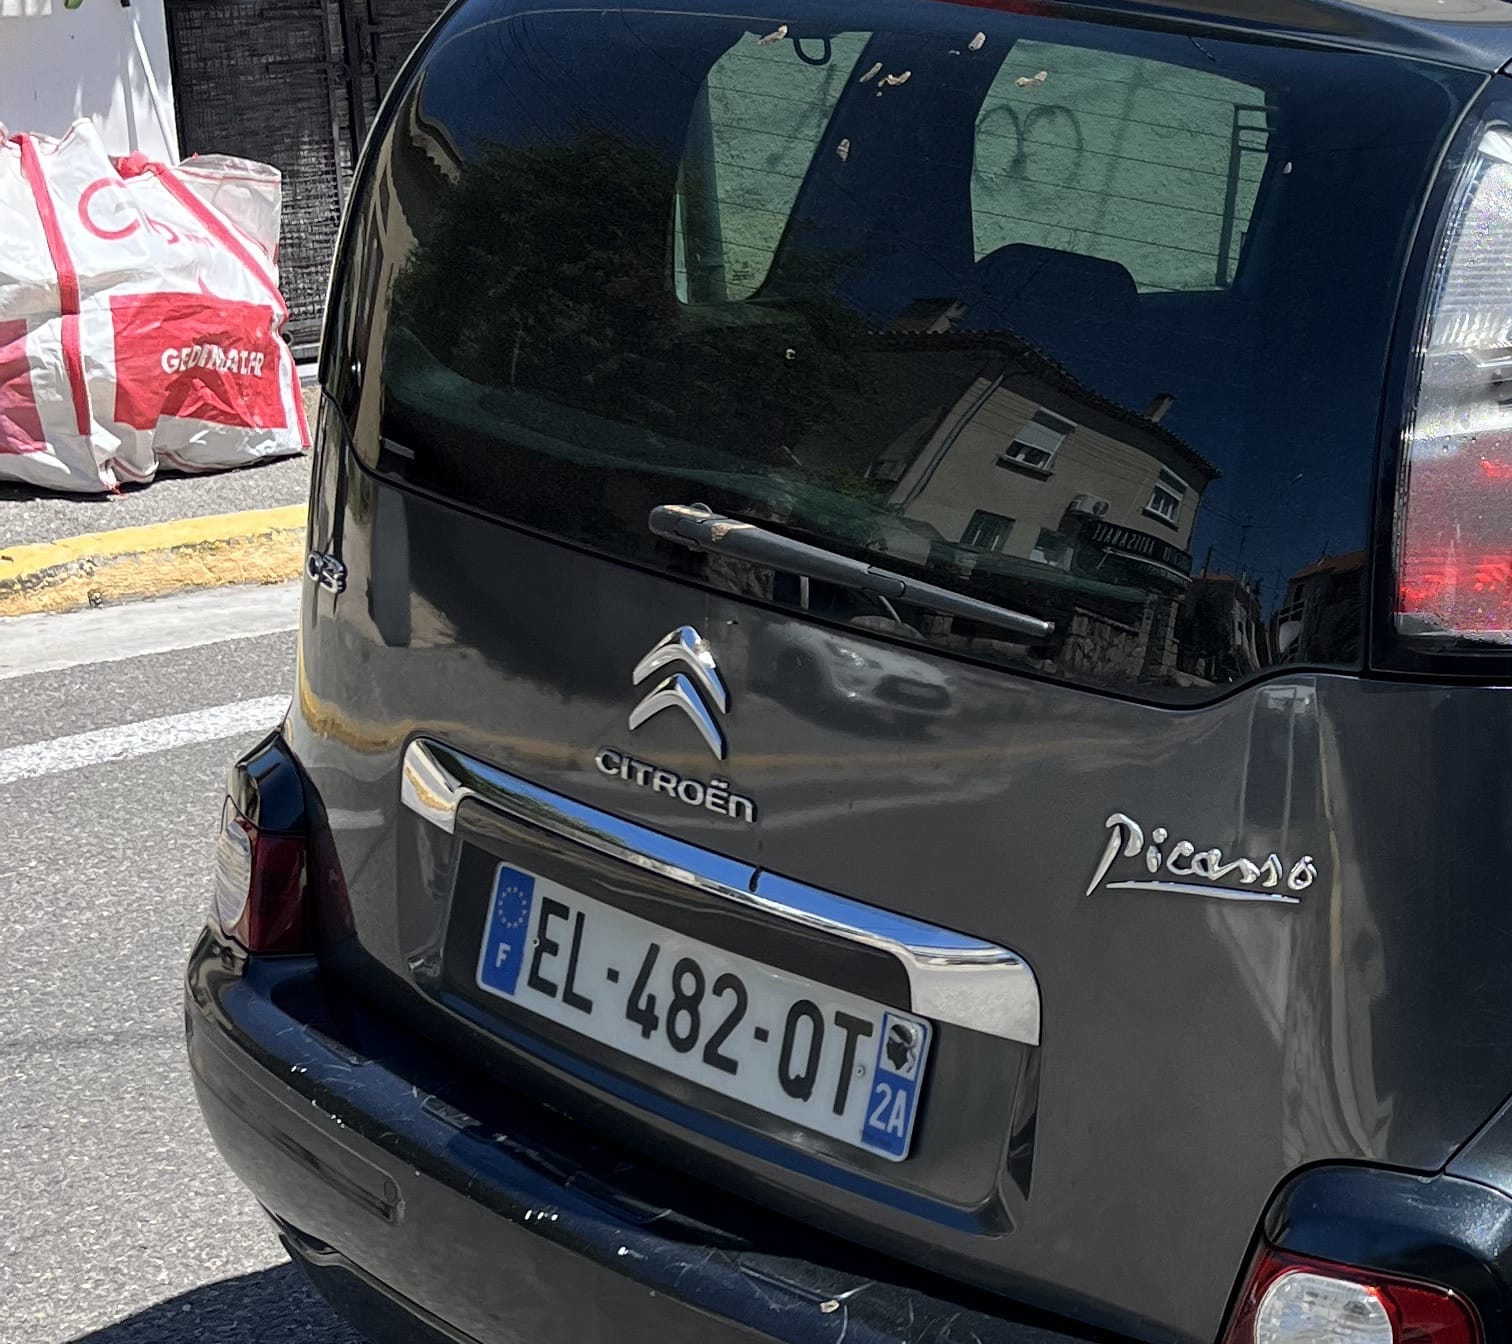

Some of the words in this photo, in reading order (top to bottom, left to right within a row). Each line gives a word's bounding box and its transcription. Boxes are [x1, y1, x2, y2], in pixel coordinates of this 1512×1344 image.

[1086, 812, 1318, 898] Picasso
[495, 942, 512, 968] F
[527, 896, 875, 1117] EL-482-QT
[868, 1081, 908, 1139] 2A
